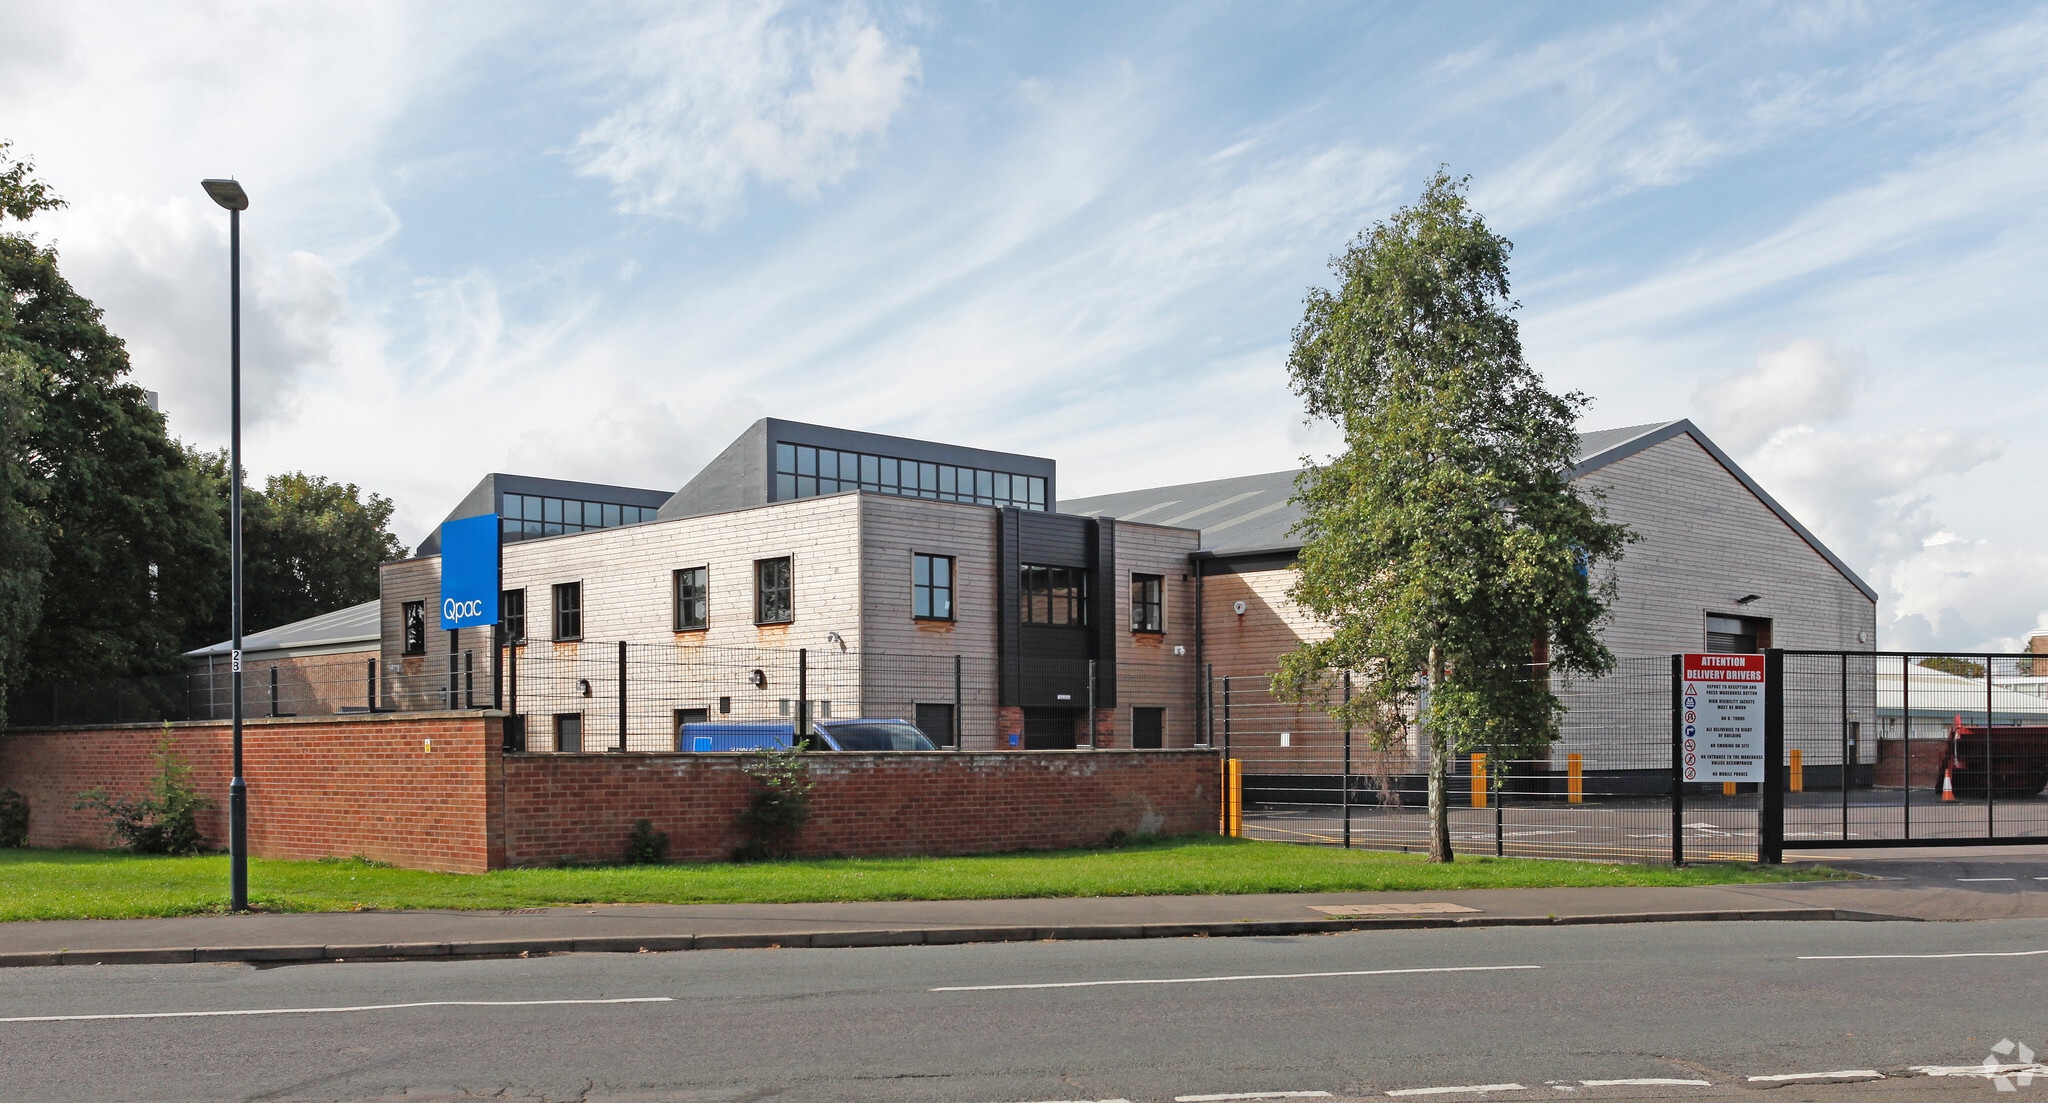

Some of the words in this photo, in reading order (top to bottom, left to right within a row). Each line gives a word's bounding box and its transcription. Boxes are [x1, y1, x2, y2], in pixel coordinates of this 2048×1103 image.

[444, 598, 482, 624] Qpac
[1702, 657, 1745, 666] ATTENTION
[1687, 670, 1724, 679] DELIVERY
[1726, 671, 1761, 680] DRIVERS
